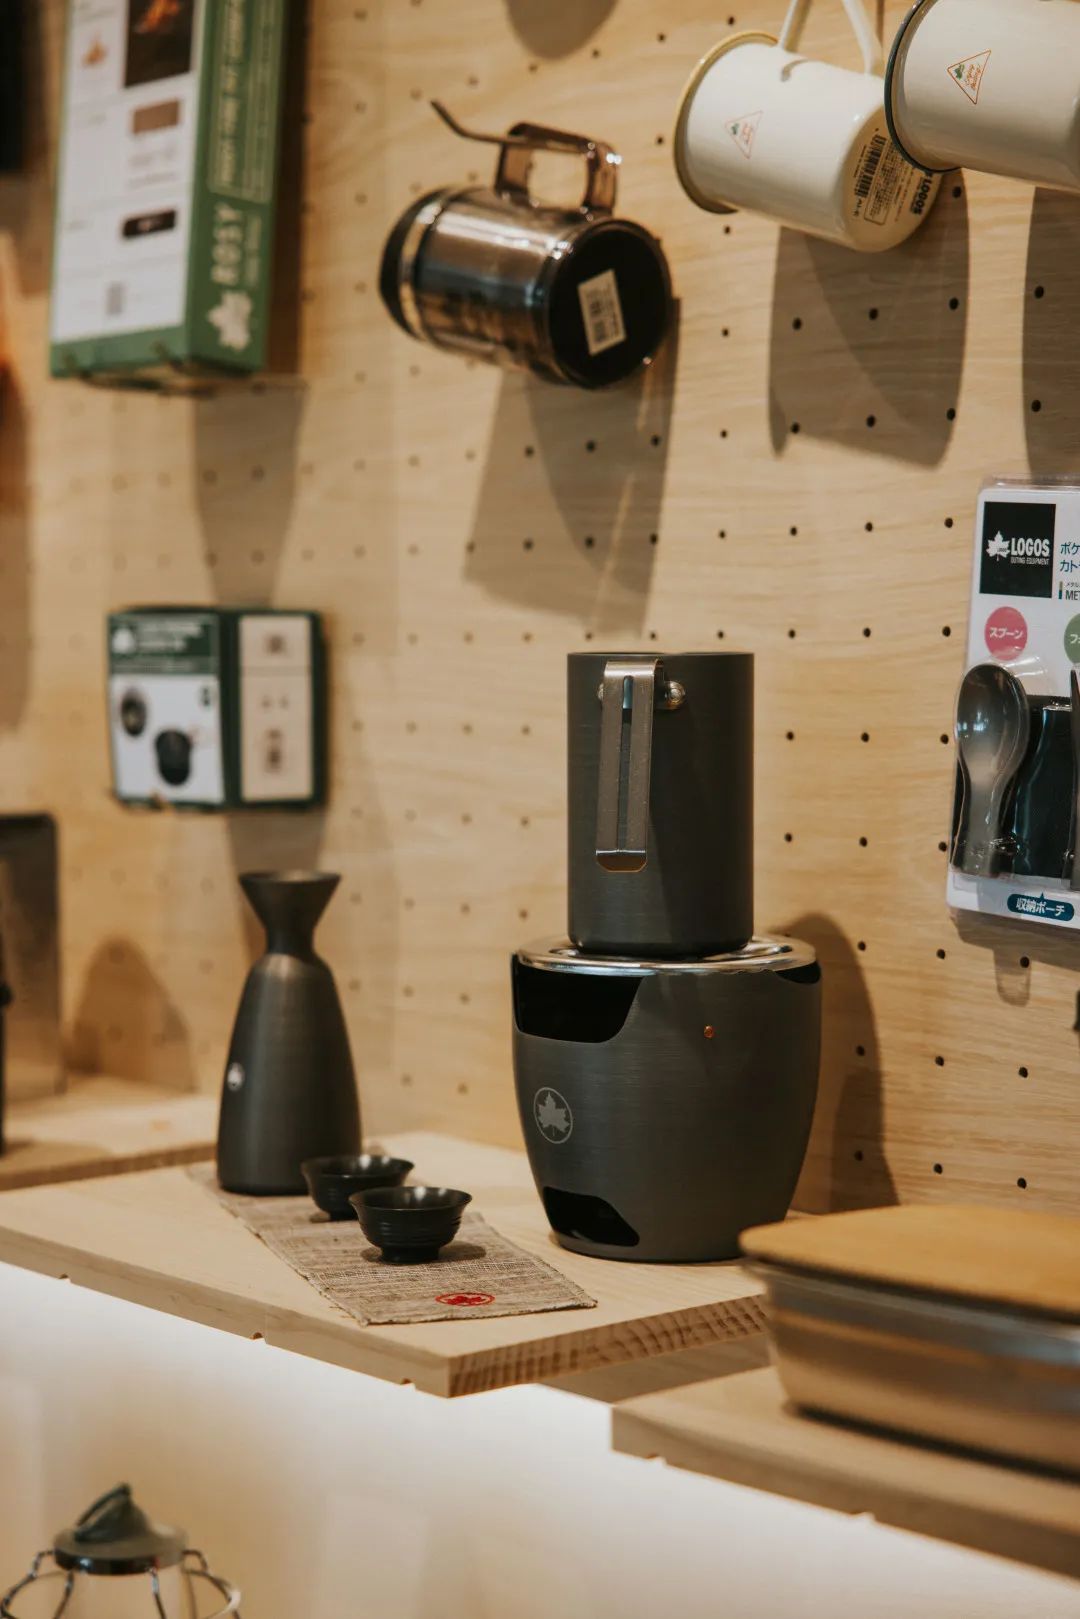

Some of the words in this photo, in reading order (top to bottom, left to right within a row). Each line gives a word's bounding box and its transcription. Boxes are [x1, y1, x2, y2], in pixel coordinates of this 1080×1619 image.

[1010, 537, 1050, 558] LOGOS
[1060, 560, 1080, 573] カト
[989, 626, 1023, 640] スプーン
[1016, 898, 1065, 915] 収納ポーチ
